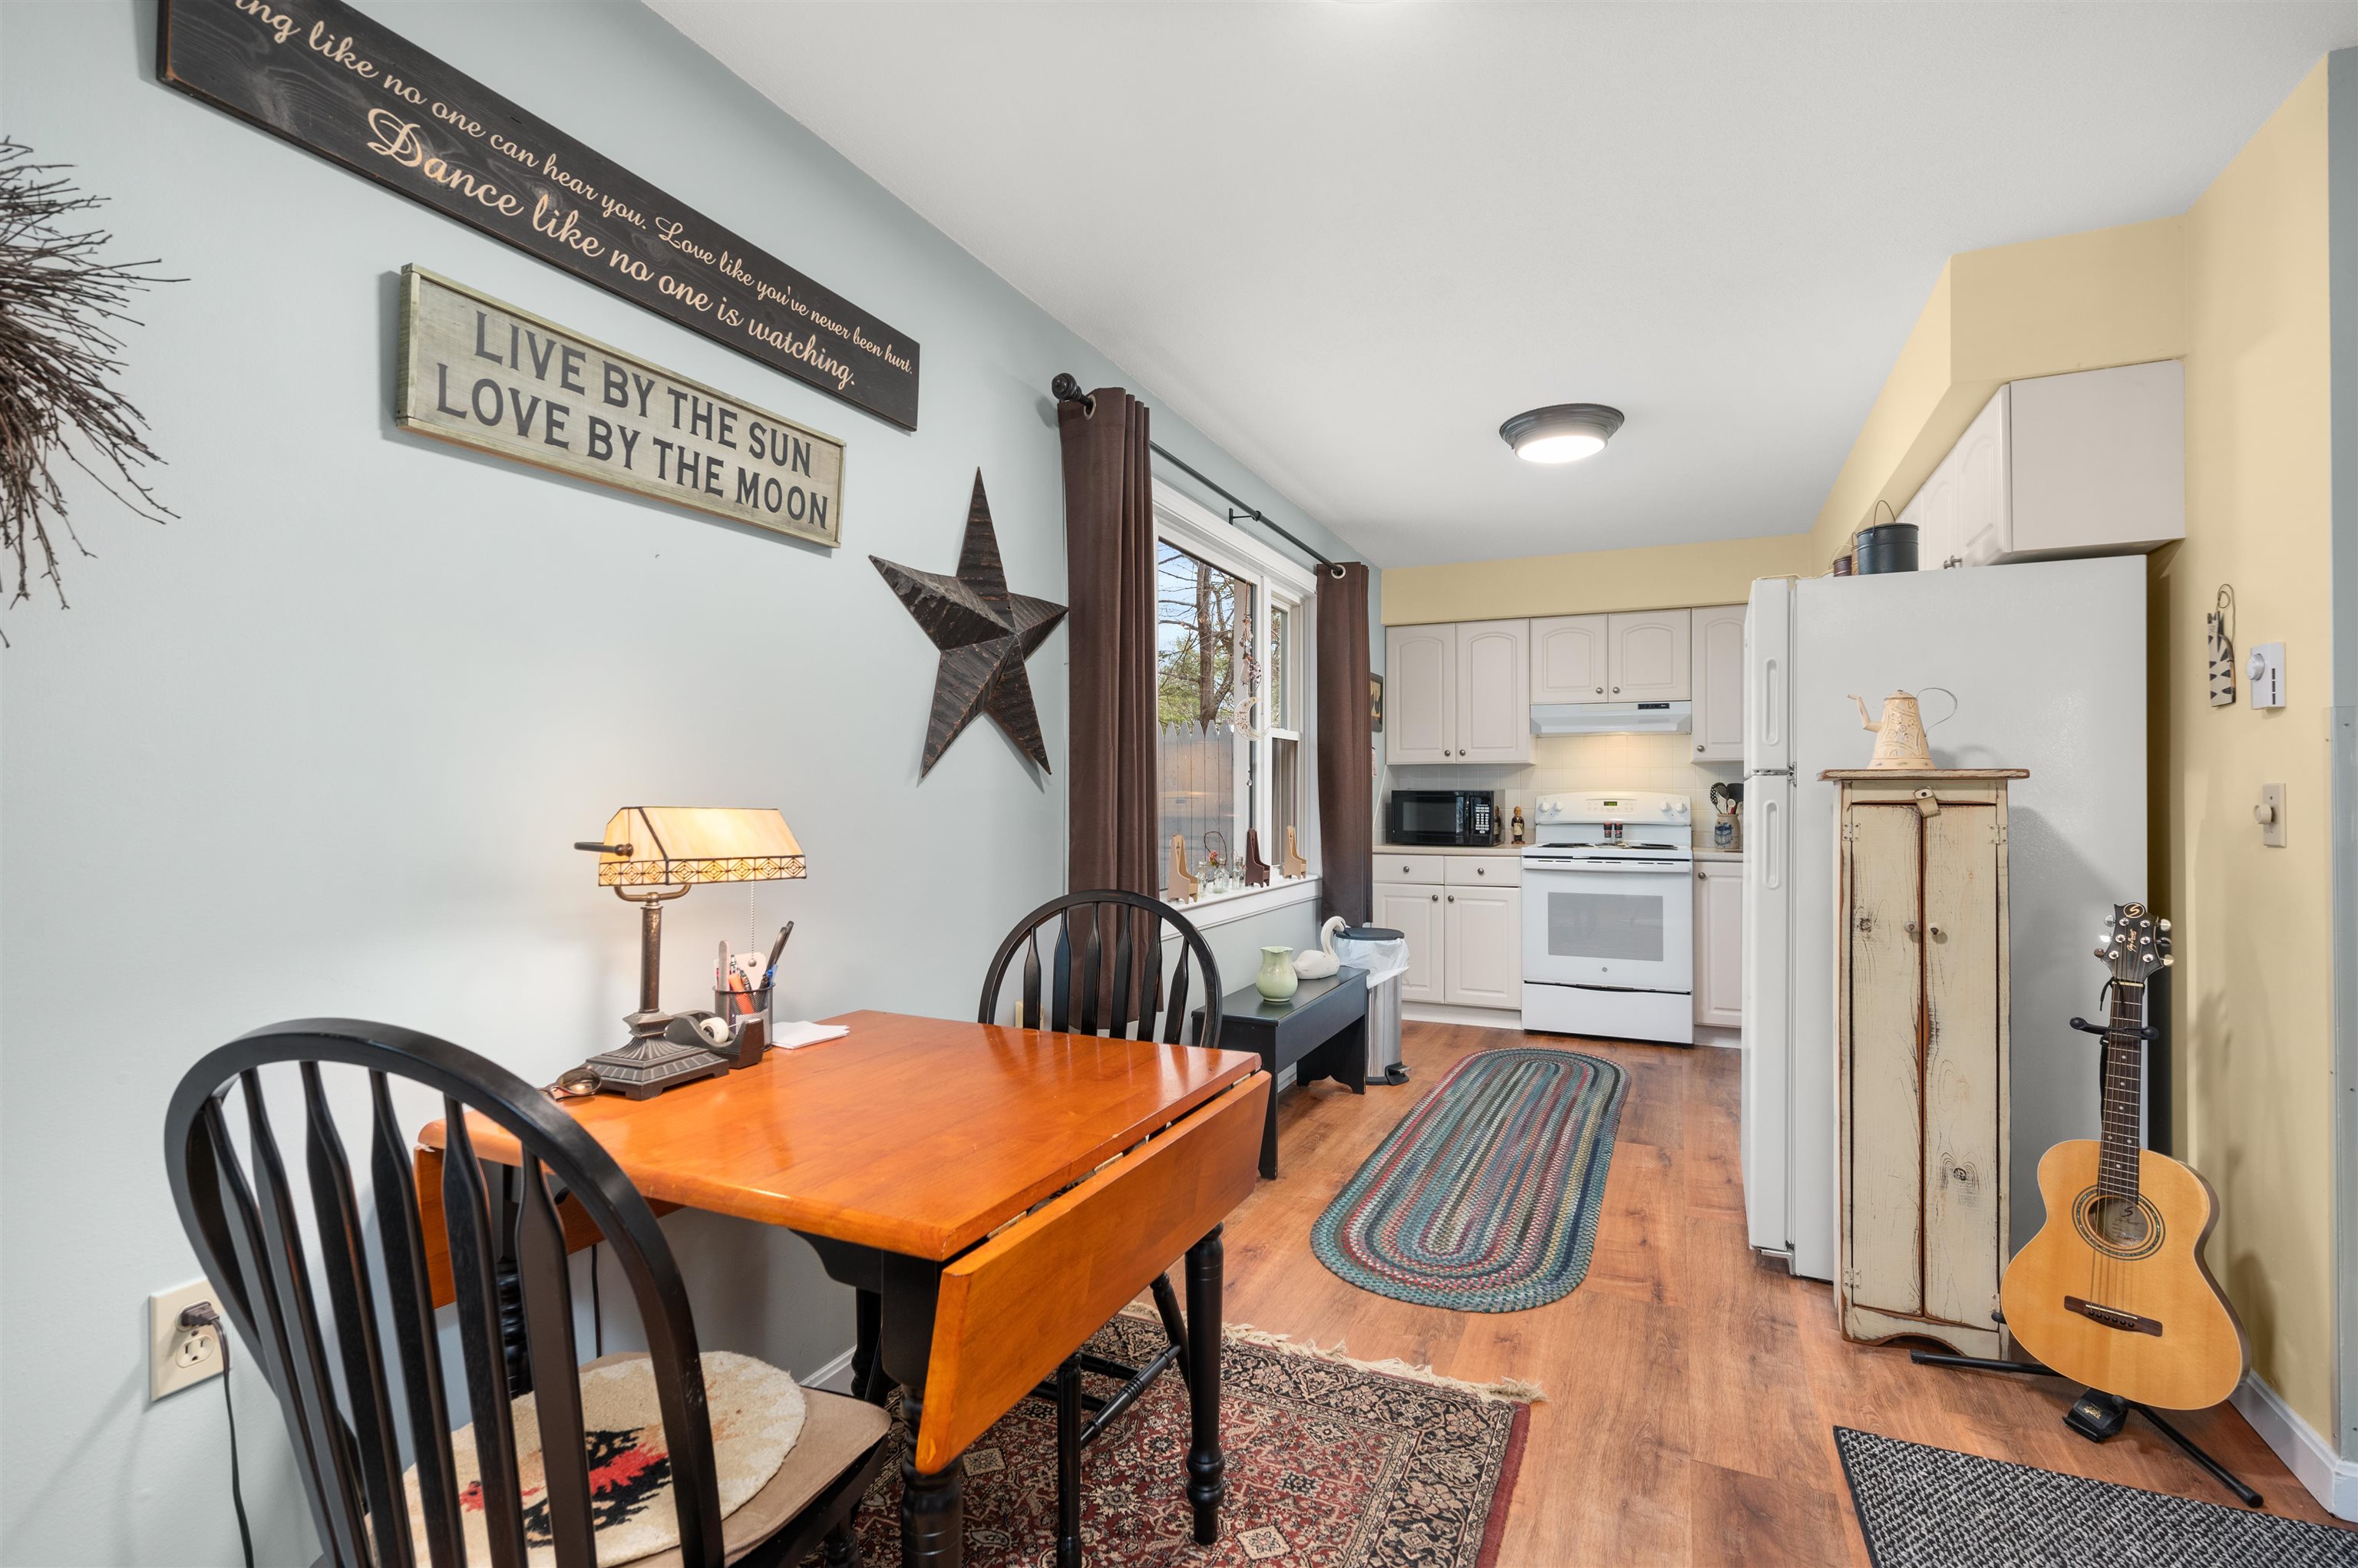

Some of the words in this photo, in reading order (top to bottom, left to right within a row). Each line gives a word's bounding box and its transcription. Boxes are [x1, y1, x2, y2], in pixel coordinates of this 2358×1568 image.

[235, 0, 302, 44] ing
[309, 20, 379, 78] like
[383, 74, 428, 104] no
[431, 102, 487, 137] one
[490, 134, 540, 167] can
[543, 153, 599, 200] hear
[601, 194, 647, 229] you.
[655, 216, 717, 265] Love
[719, 250, 755, 286] like
[757, 280, 810, 316] you've
[810, 310, 851, 339] never
[853, 326, 883, 357] been
[884, 344, 913, 374] hurt.
[366, 107, 525, 216] Dance
[532, 189, 606, 257] like
[609, 249, 655, 282] no
[659, 275, 714, 312] one
[717, 296, 745, 327] is
[748, 319, 855, 390] watching.
[437, 362, 570, 451] LOVE
[586, 415, 641, 470] BY
[652, 437, 724, 498] THE
[735, 467, 829, 530] MOON
[475, 311, 586, 396] LIVE
[603, 360, 656, 418] BY
[667, 386, 738, 450] THE
[748, 421, 812, 478] SUN
